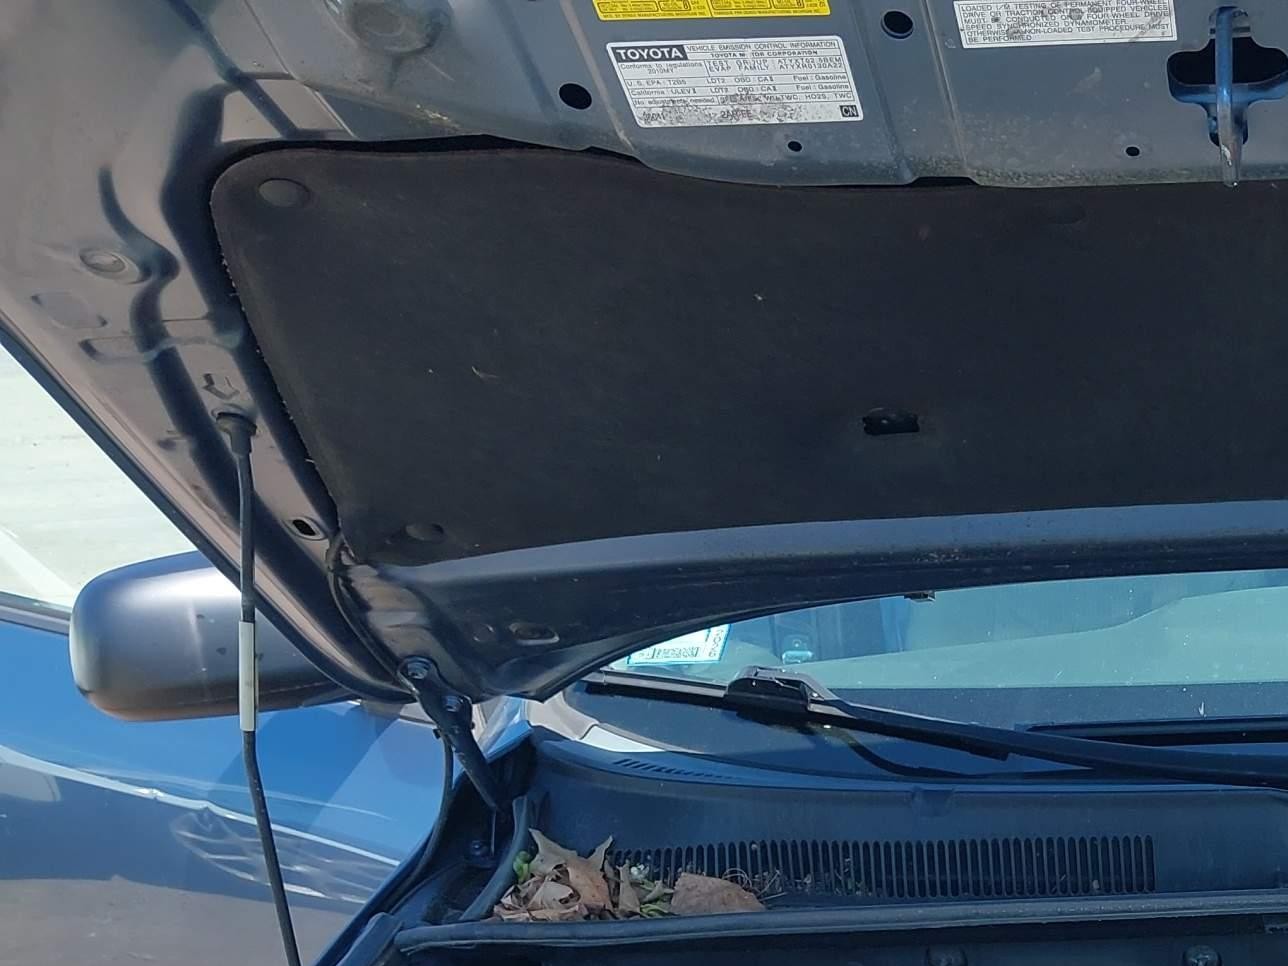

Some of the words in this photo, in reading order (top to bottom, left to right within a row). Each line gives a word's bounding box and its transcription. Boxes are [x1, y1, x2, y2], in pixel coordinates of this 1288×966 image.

[754, 41, 787, 49] CONTROL
[790, 40, 836, 48] INFORMATION
[616, 47, 684, 60] TOYOTA
[815, 73, 847, 81] Gasoline
[817, 82, 850, 90] Gasoline
[842, 106, 858, 117] CN
